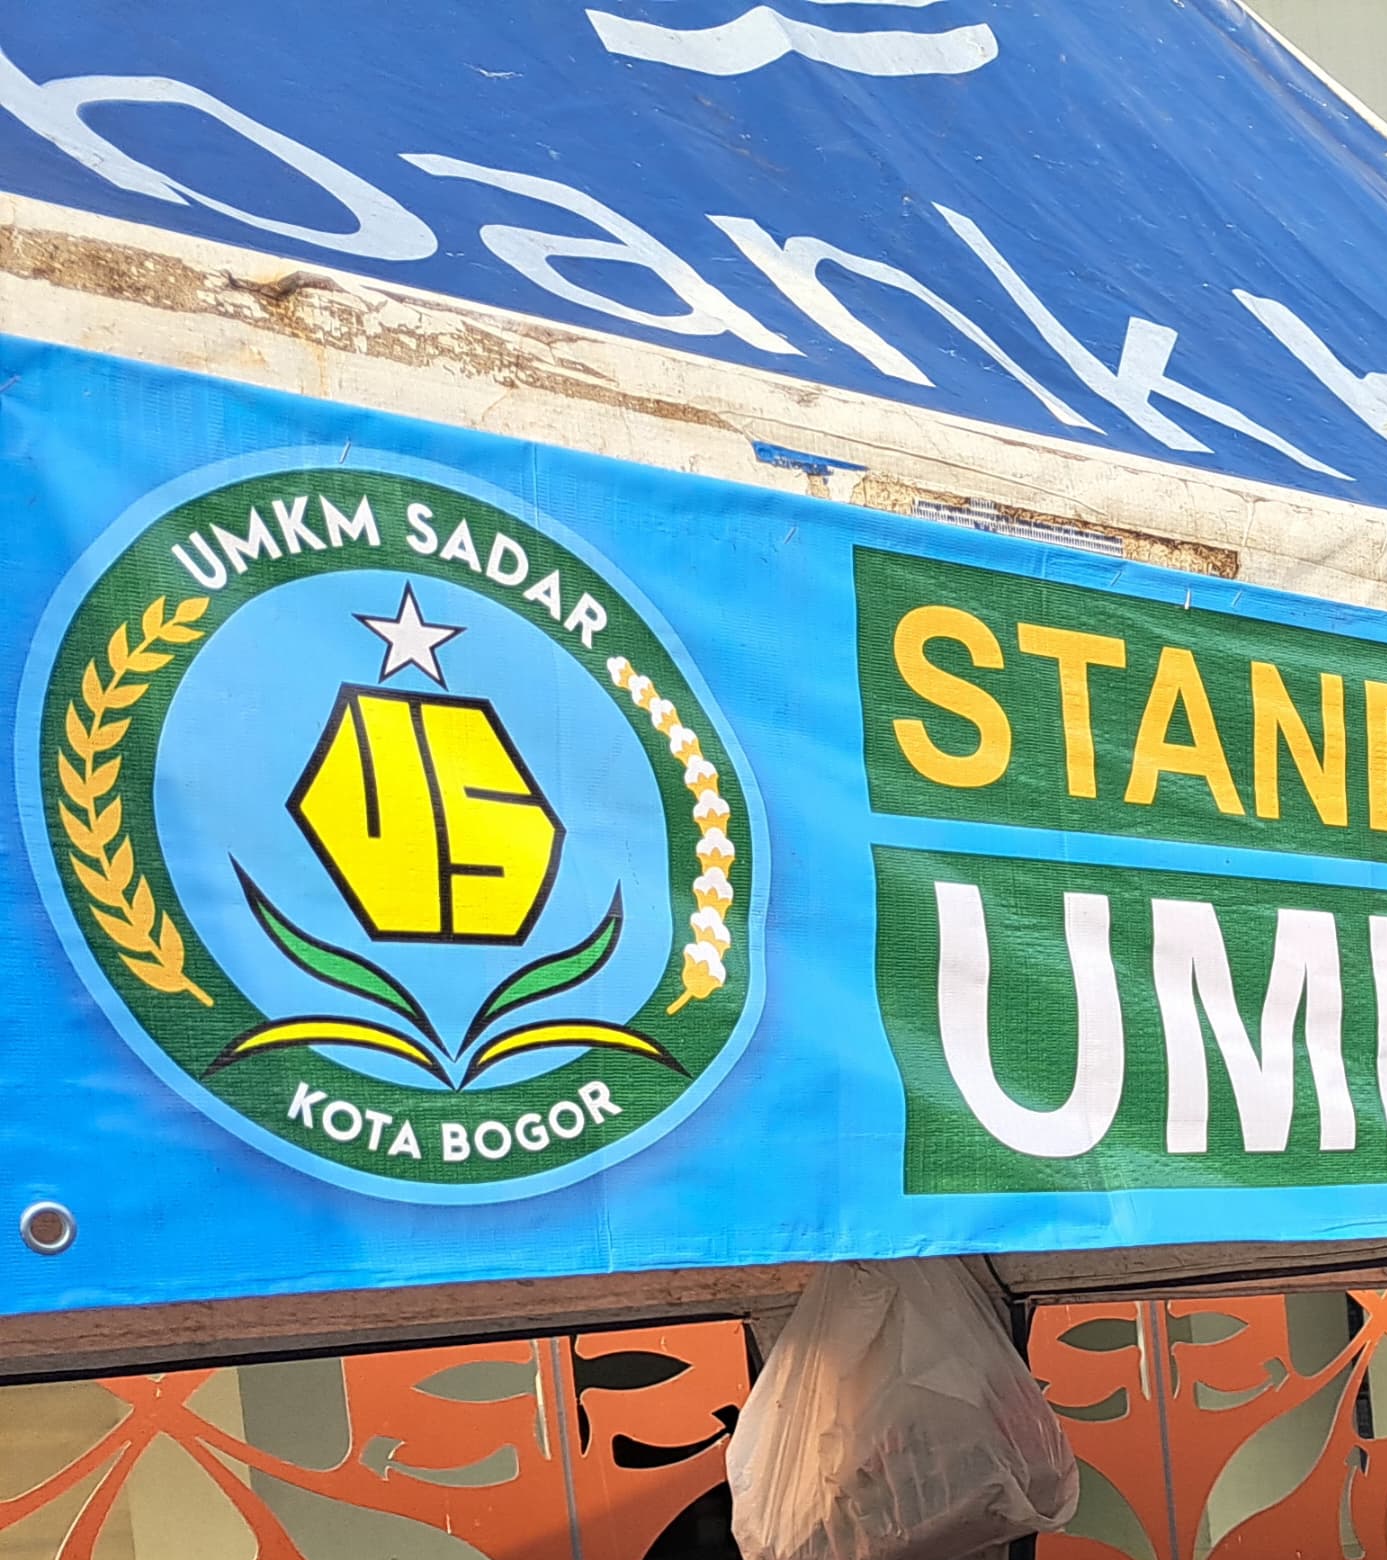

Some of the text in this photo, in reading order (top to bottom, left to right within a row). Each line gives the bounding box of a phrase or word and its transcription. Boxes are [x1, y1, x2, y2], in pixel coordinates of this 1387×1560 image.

[172, 495, 608, 648] UMKM SADAR
[288, 1079, 622, 1163] KOTA BOGOR
